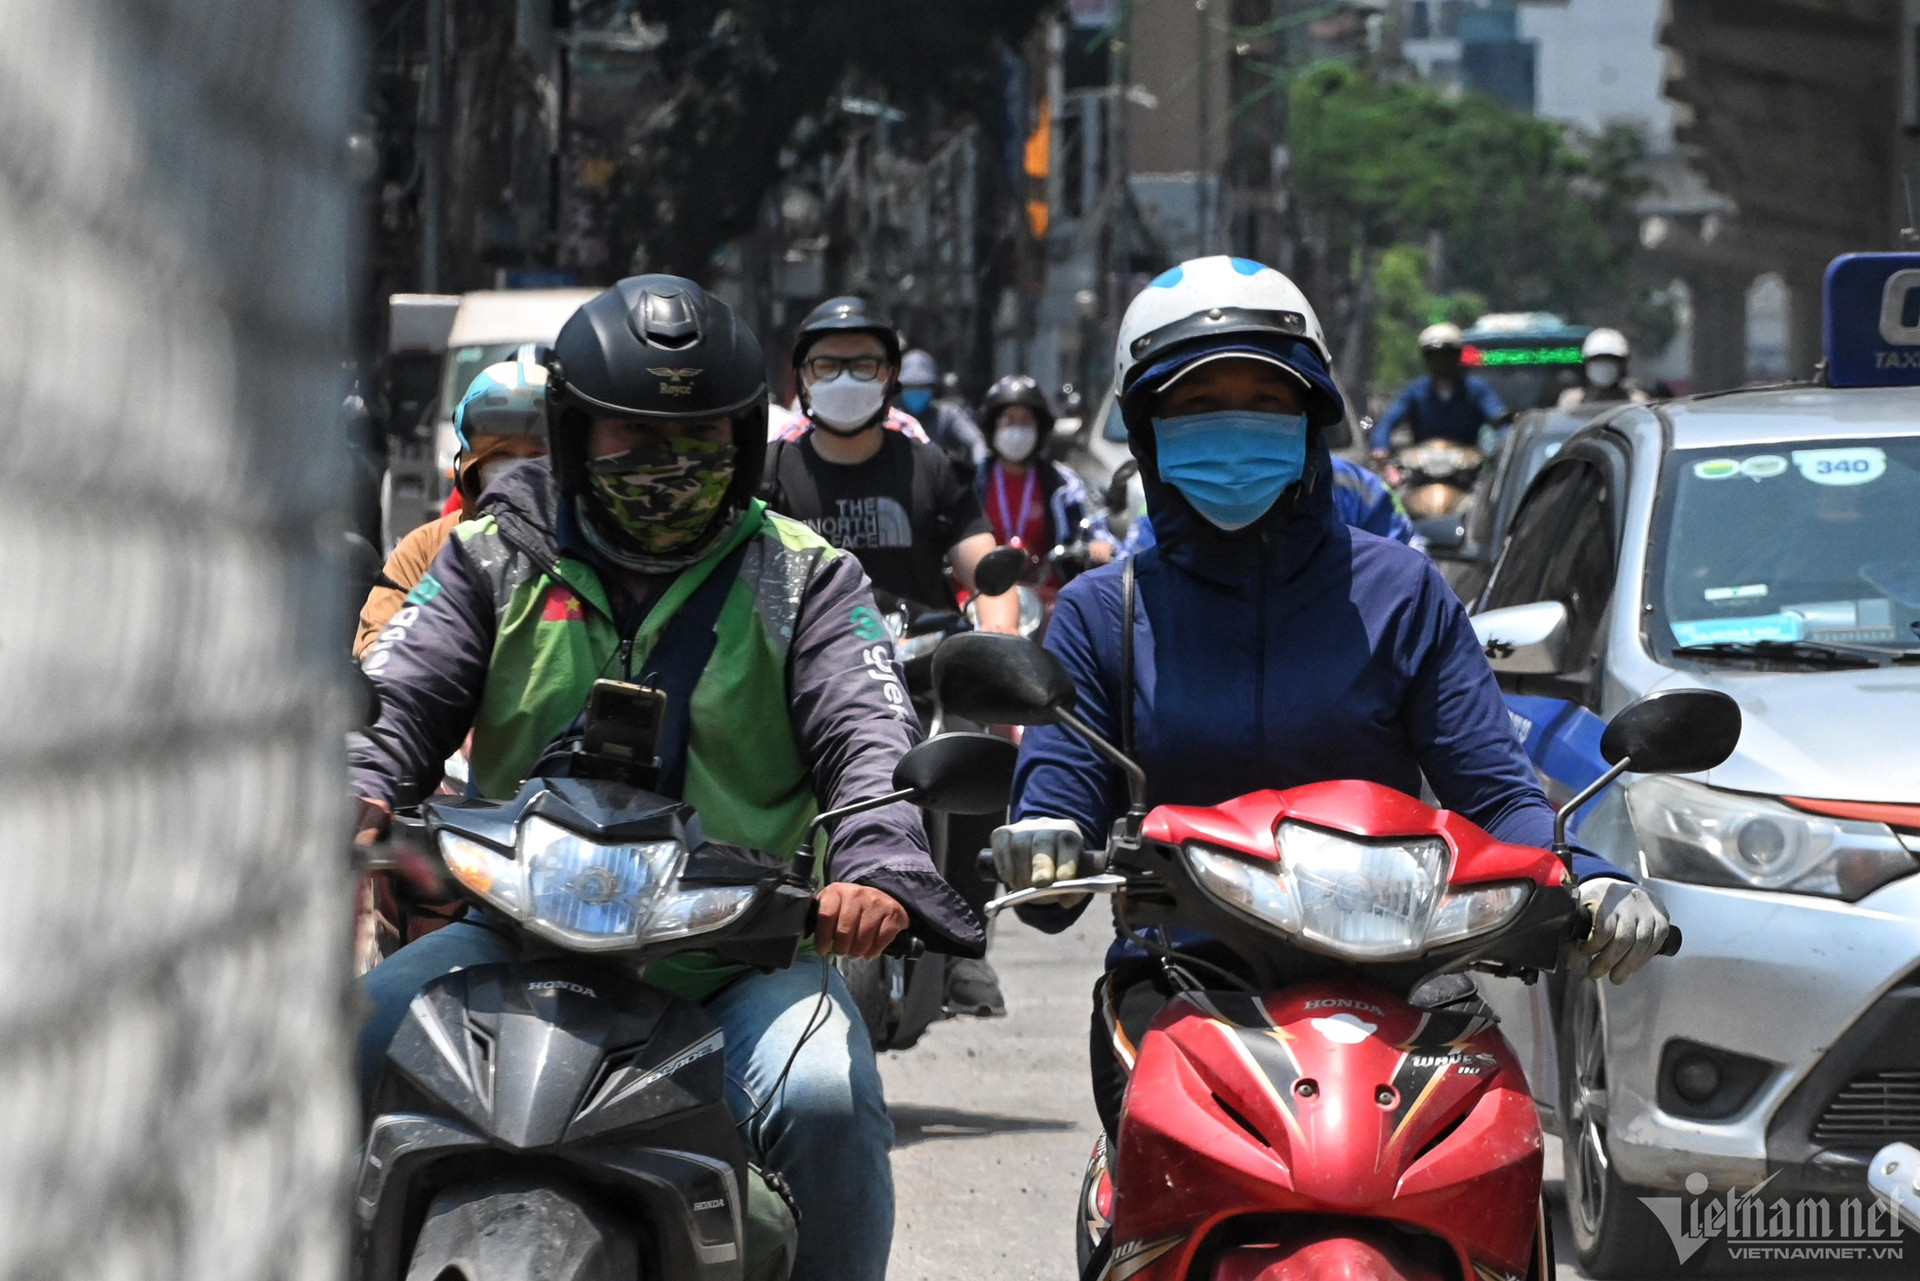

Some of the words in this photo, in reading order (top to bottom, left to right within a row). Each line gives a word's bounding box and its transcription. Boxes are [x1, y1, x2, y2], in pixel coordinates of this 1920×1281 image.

[1817, 459, 1869, 474] 340
[836, 499, 877, 515] THE
[807, 516, 878, 535] NORTH
[832, 531, 878, 549] FACE
[527, 980, 597, 998] HONDA
[1304, 998, 1385, 1017] HONDA
[693, 1198, 725, 1211] HONDA
